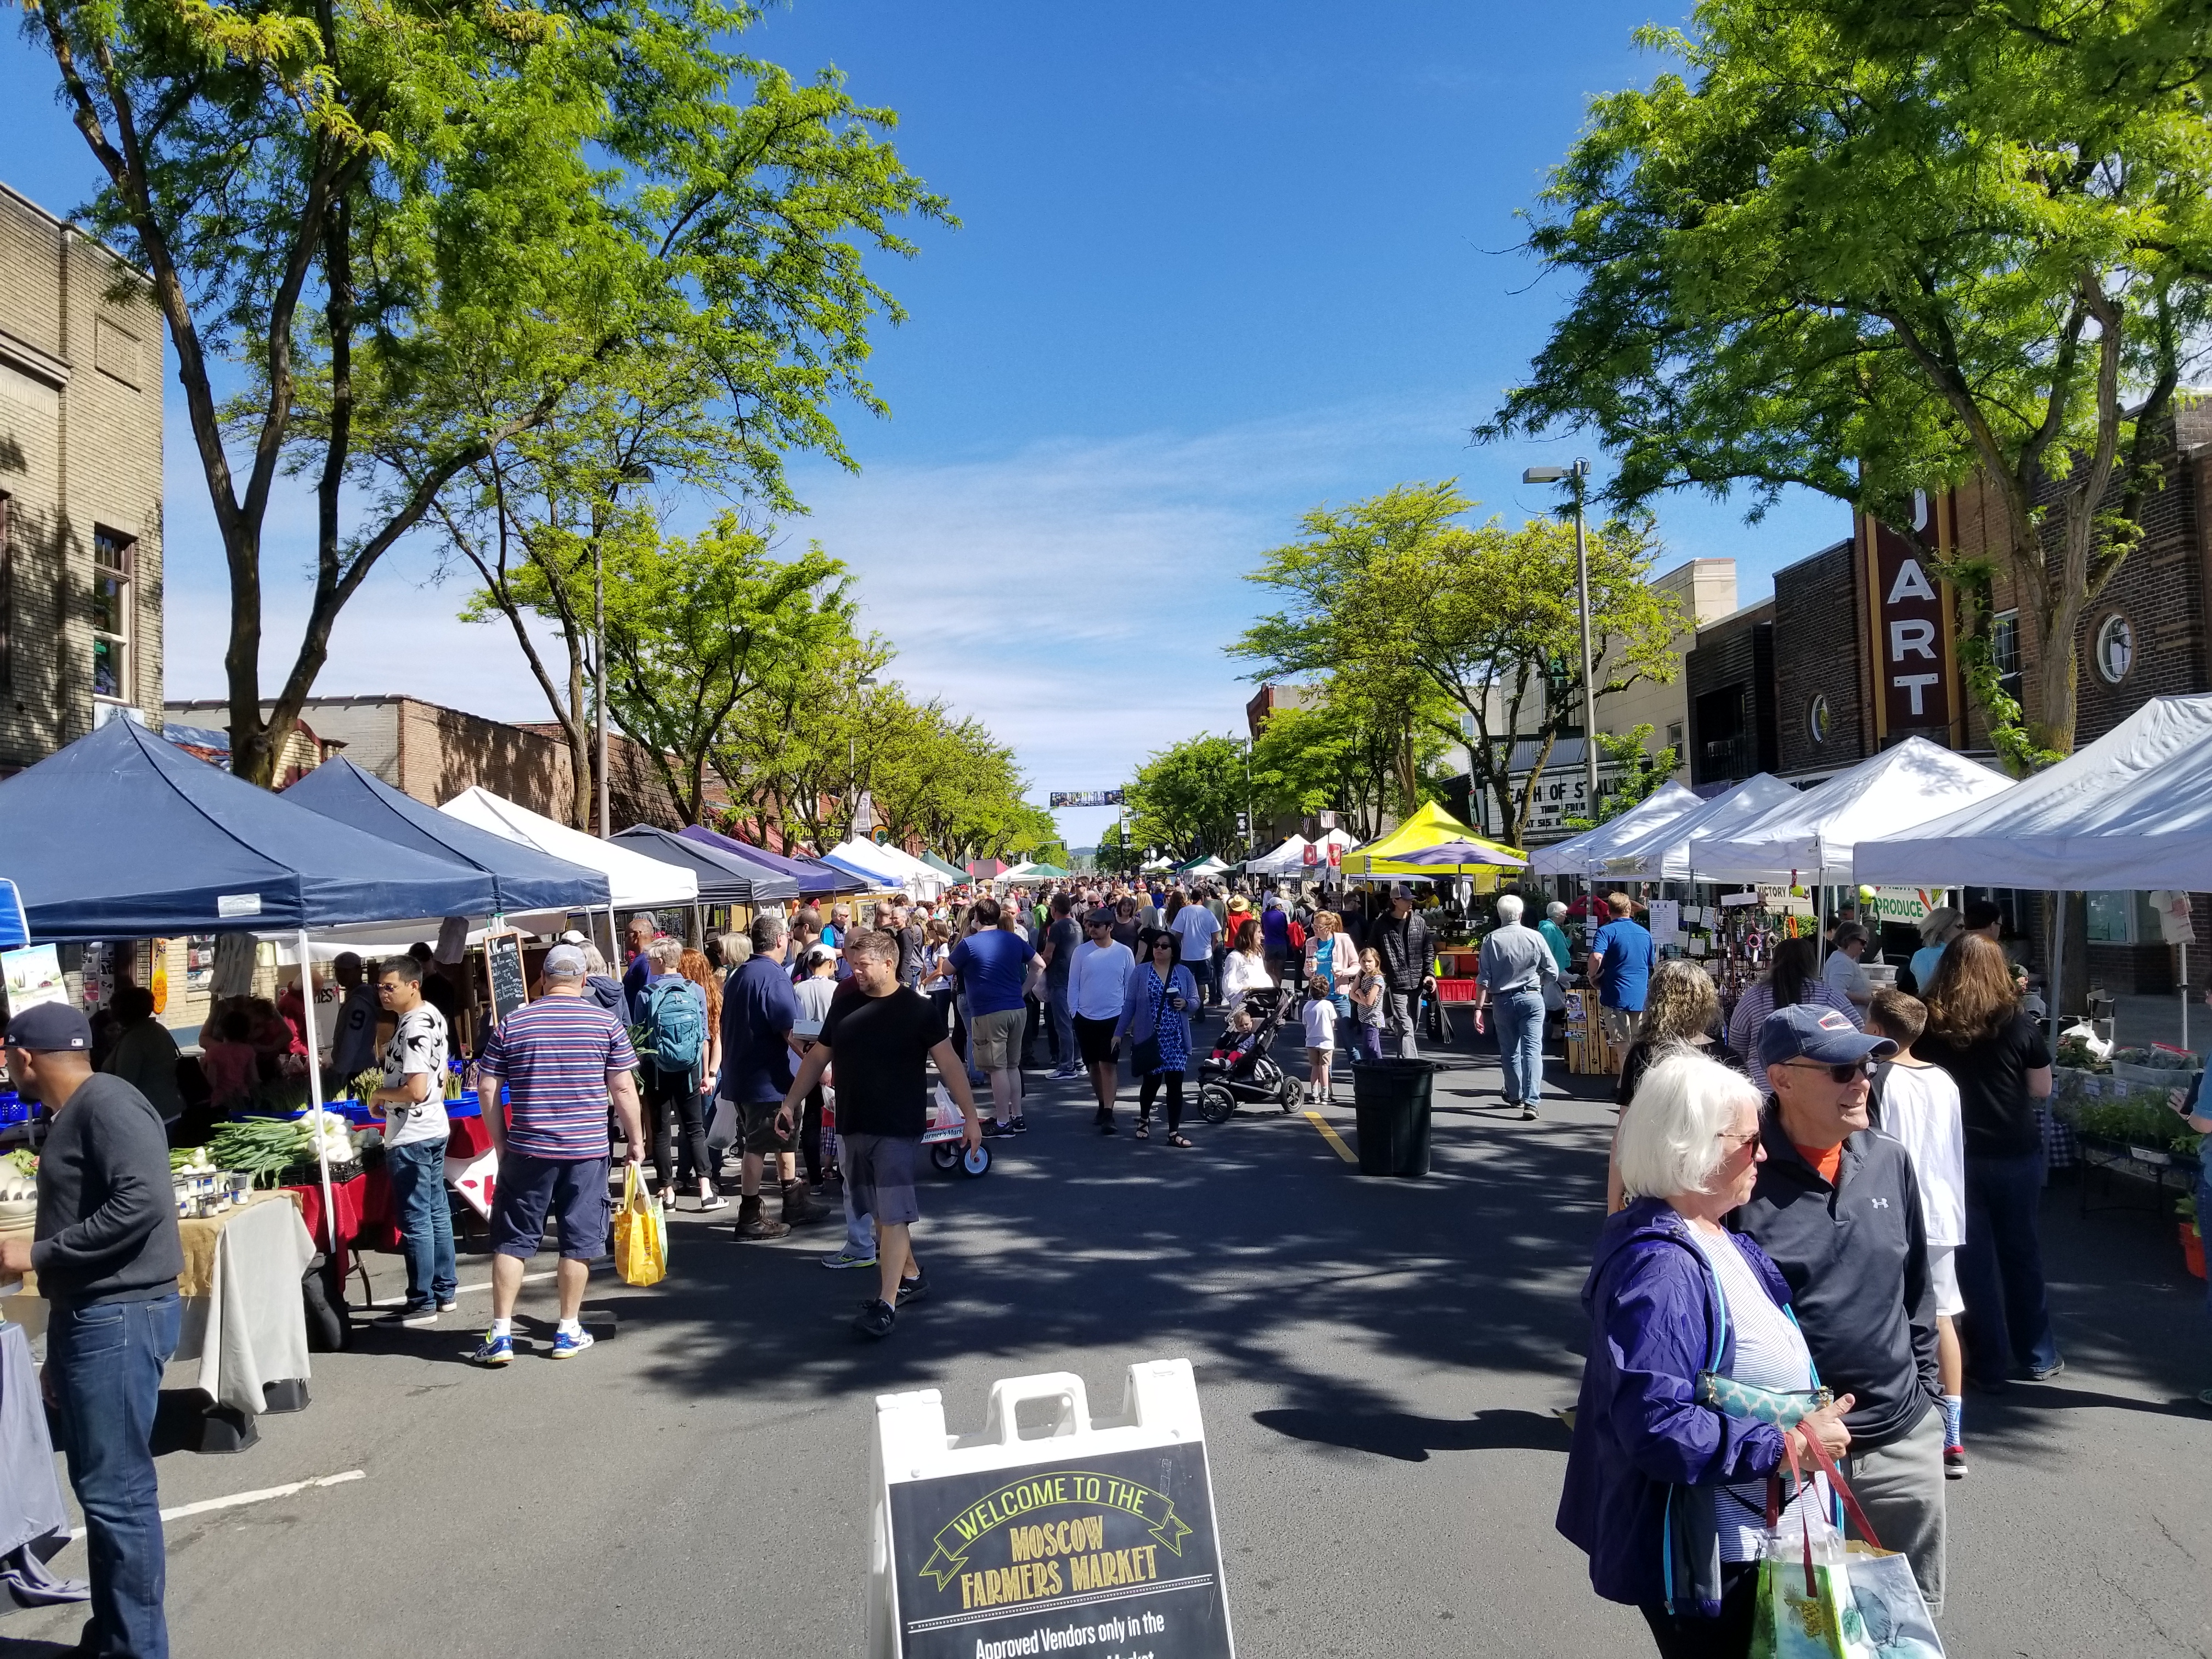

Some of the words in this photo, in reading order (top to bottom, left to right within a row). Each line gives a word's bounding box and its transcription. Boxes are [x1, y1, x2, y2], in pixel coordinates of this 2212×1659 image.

[1549, 783, 1567, 800] OF
[1757, 885, 1787, 898] VICTORY
[1872, 898, 1924, 918] PRODUCE
[349, 1009, 366, 1031] 9
[953, 1477, 1068, 1541] WELCOME
[1073, 1476, 1100, 1501] TO
[1108, 1480, 1148, 1514] THE
[1009, 1515, 1104, 1562] MOSCOW
[961, 1560, 1063, 1609] FARMERS
[1069, 1544, 1157, 1591] MARKET
[976, 1629, 1039, 1659] Approved
[1040, 1623, 1096, 1651] Vendors
[1098, 1617, 1124, 1643] only
[1127, 1616, 1141, 1637] in
[1142, 1611, 1165, 1633] the
